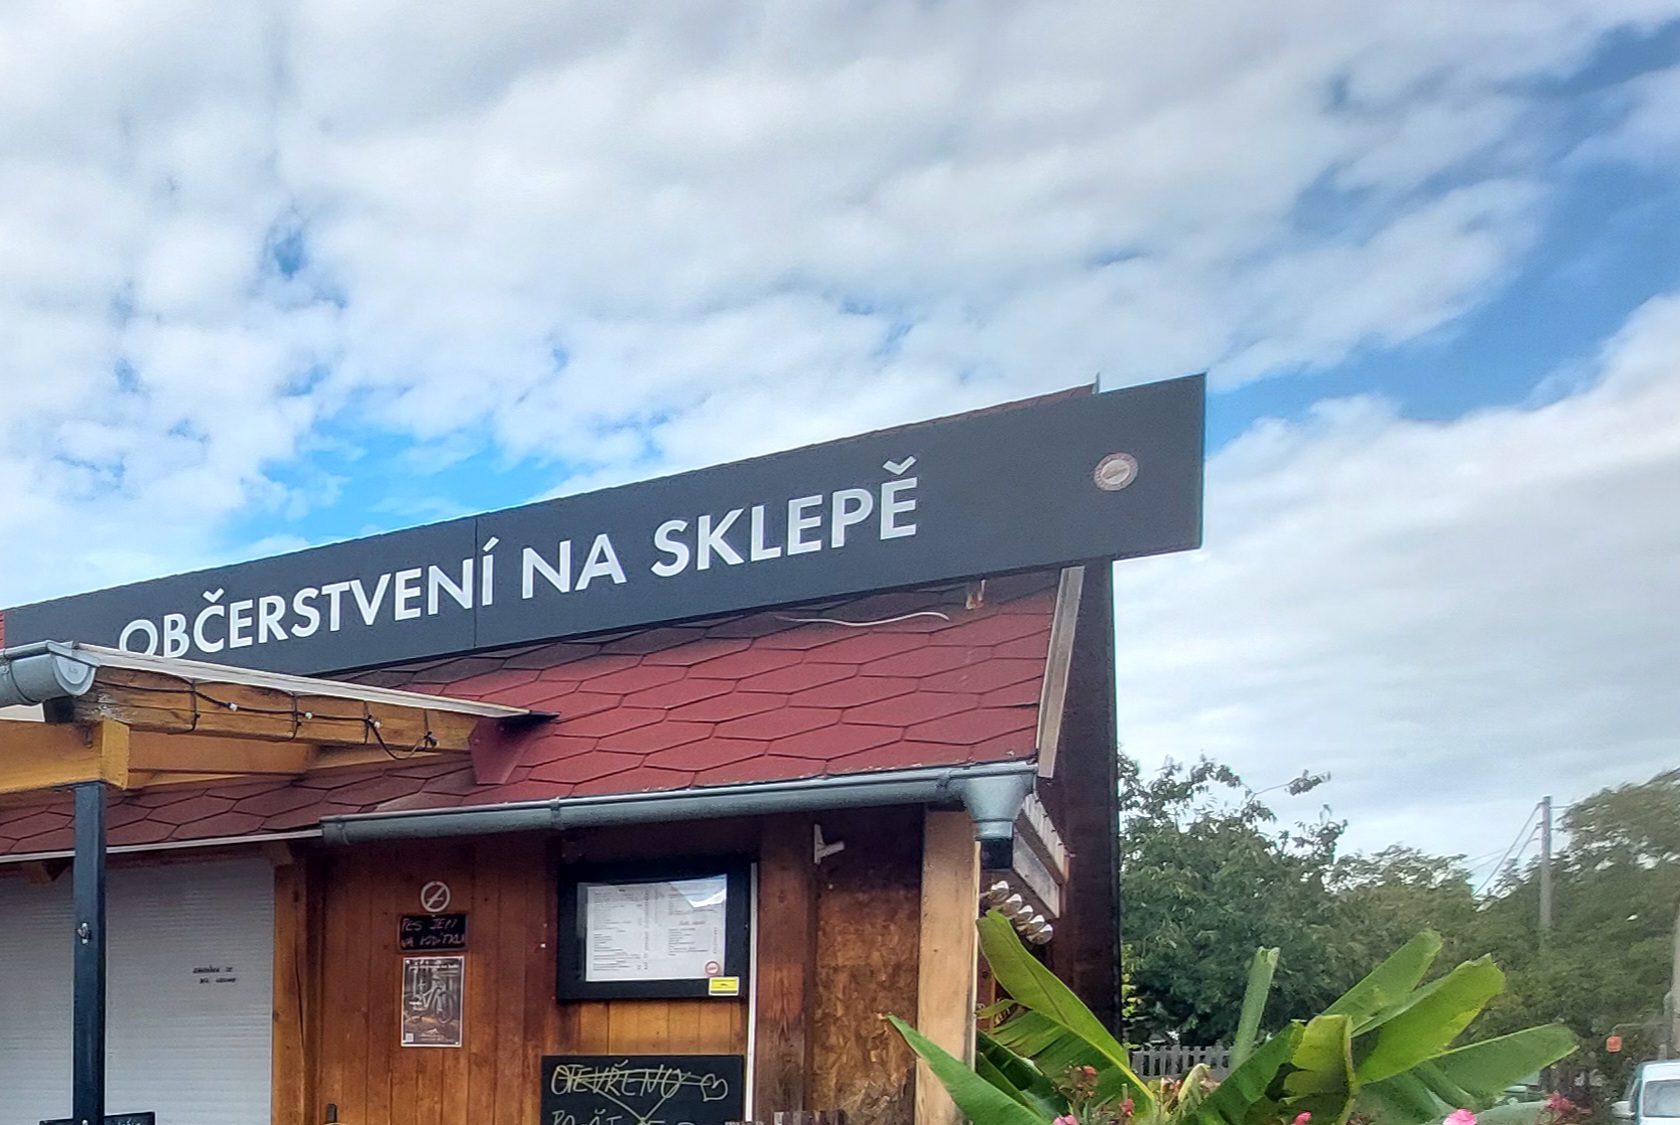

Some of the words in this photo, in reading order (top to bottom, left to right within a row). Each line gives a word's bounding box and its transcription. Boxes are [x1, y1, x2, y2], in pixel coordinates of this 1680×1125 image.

[119, 536, 500, 658] OBČERSTVENÍ
[522, 533, 627, 599] NA
[651, 455, 918, 577] SKLEPĚ
